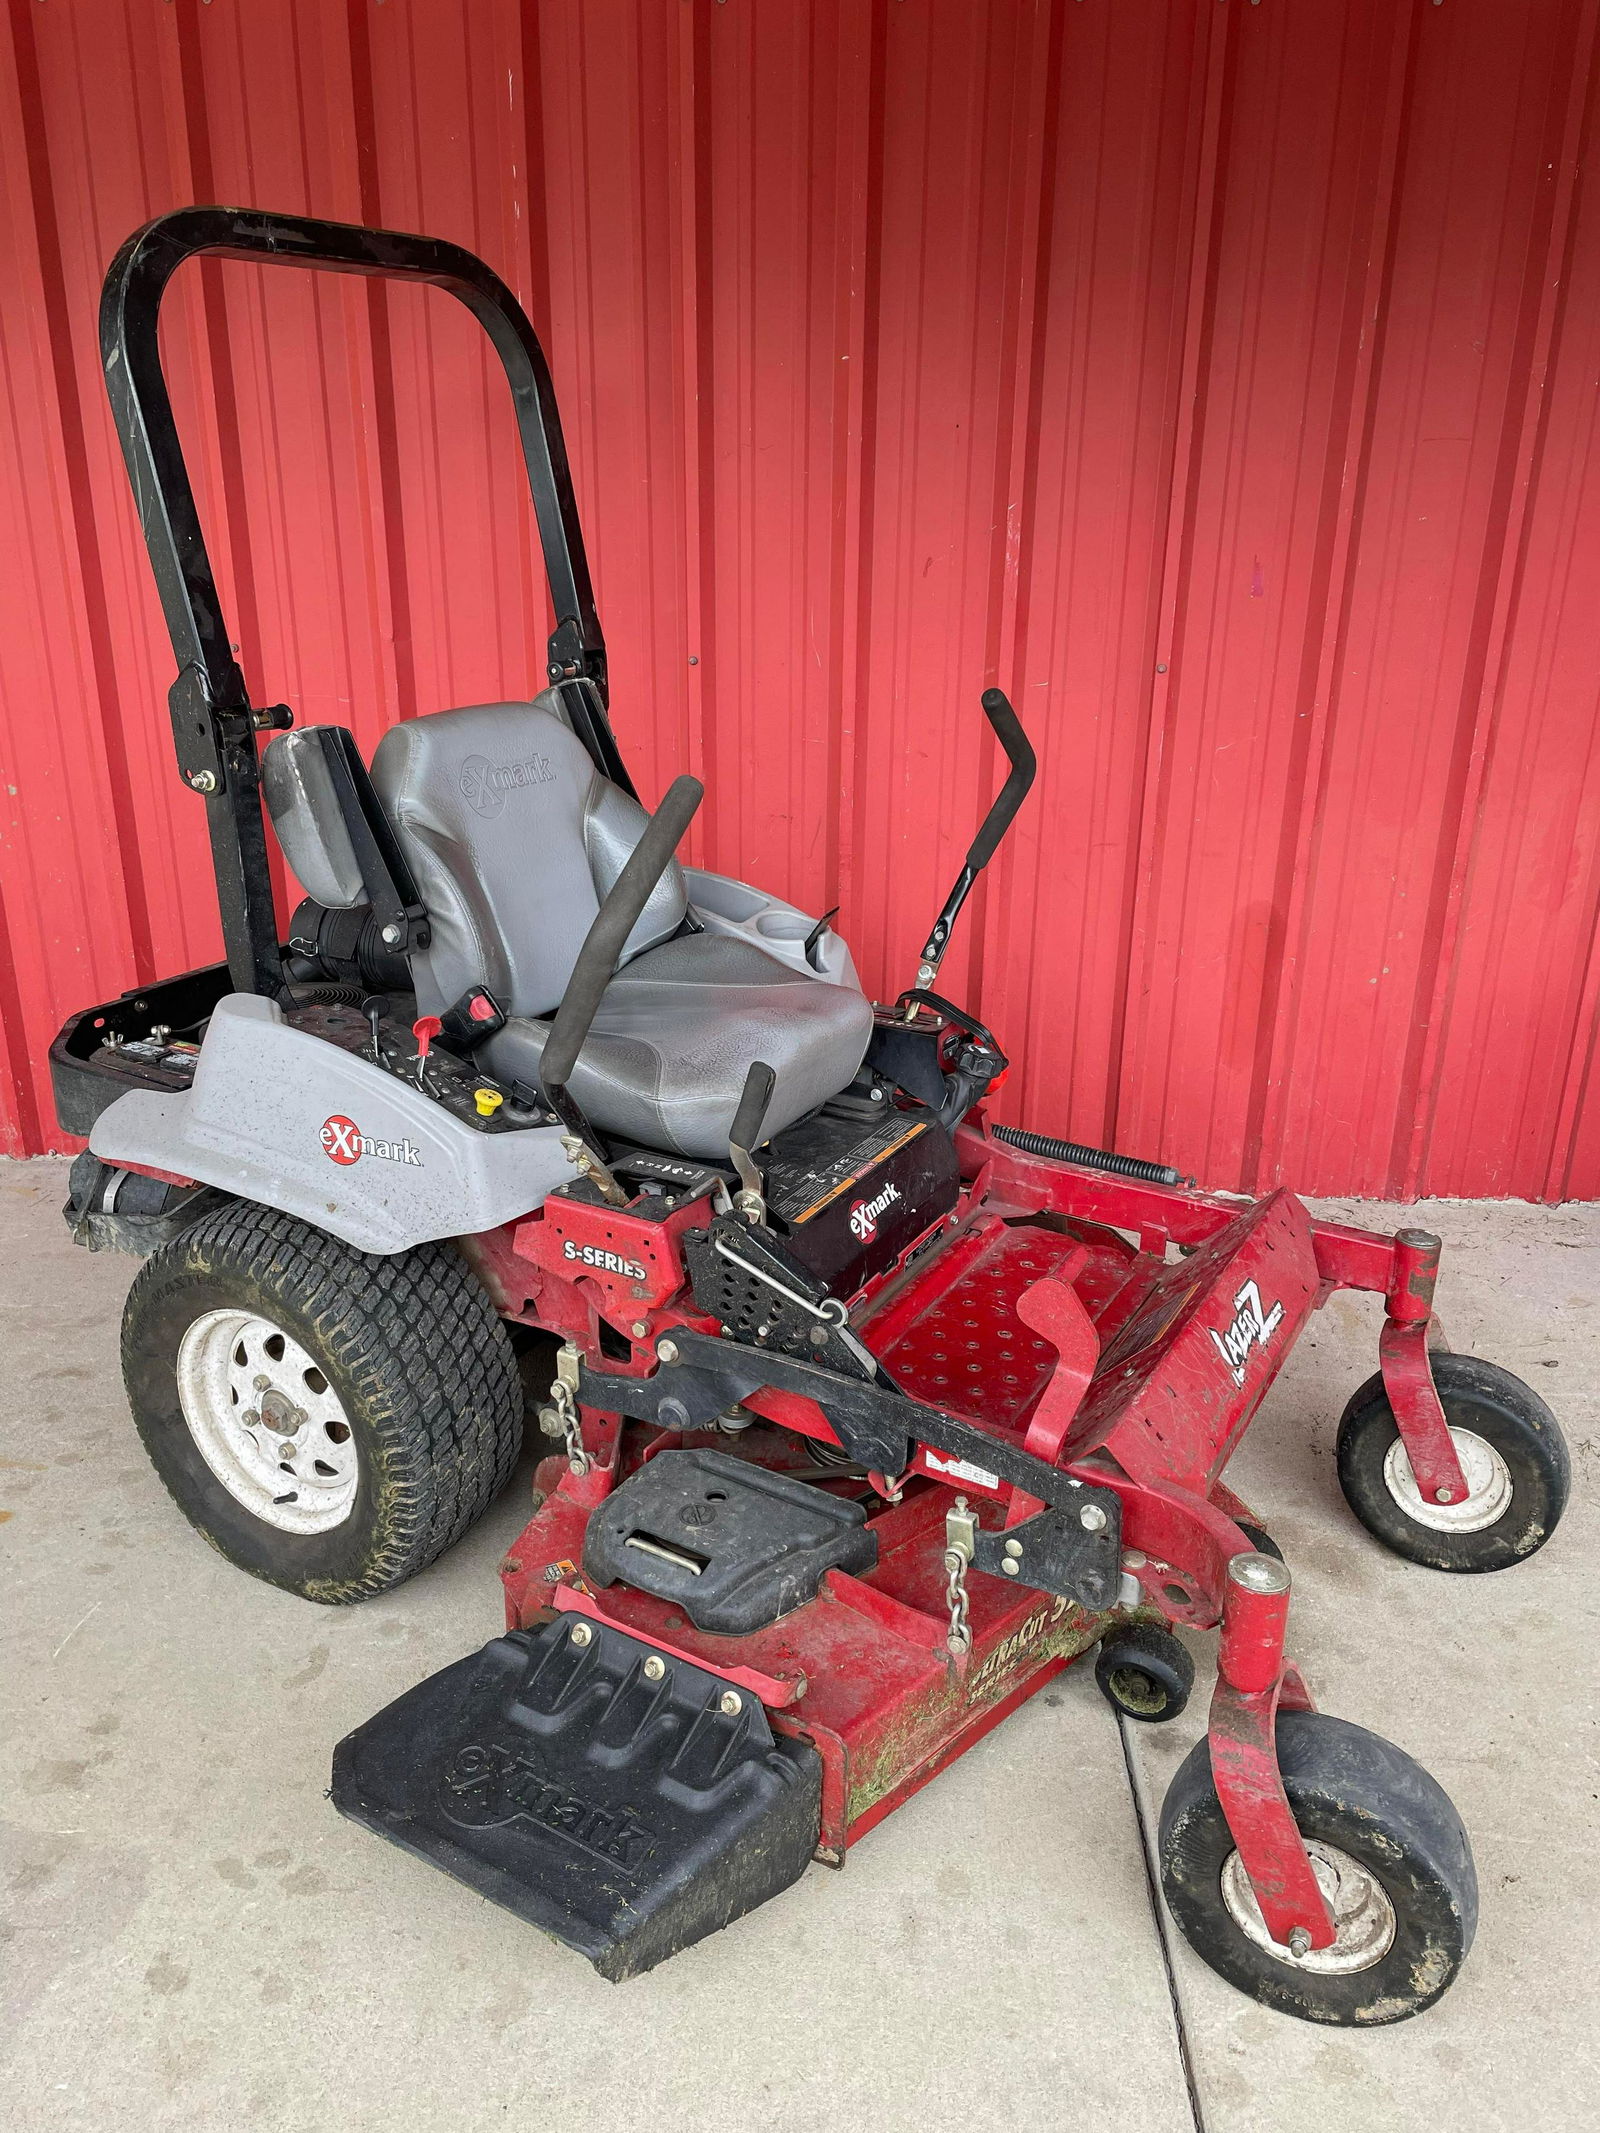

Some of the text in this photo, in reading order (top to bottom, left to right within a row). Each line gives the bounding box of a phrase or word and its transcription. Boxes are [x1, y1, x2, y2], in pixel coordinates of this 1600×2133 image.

[319, 1121, 422, 1166] eXmark
[850, 1182, 901, 1239] eXmark
[564, 1240, 647, 1281] S-SERIES
